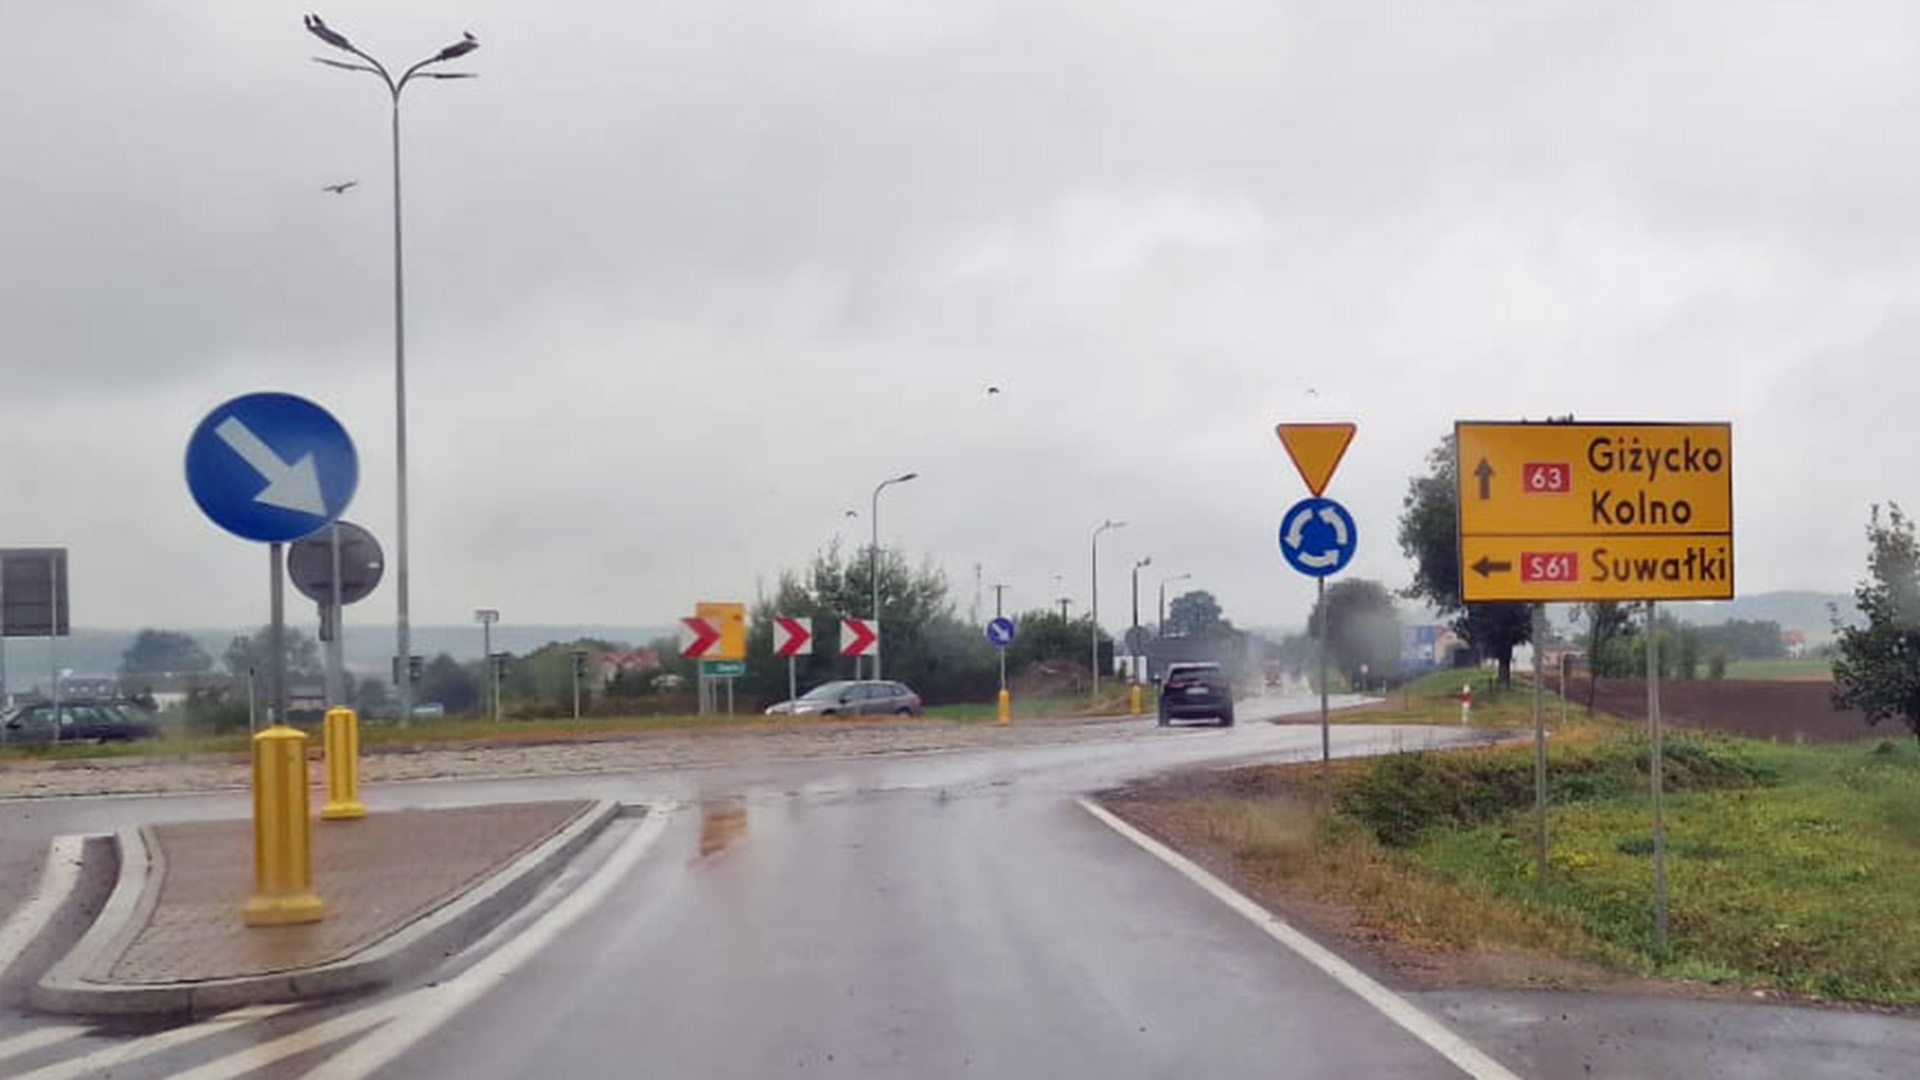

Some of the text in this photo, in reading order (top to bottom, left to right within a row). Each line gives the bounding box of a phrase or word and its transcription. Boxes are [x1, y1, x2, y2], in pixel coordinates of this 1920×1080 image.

[1588, 437, 1723, 481] Giżycko
[1531, 467, 1562, 489] 63
[1592, 490, 1692, 525] Kolno
[1531, 547, 1726, 582] S61 Suwałki
